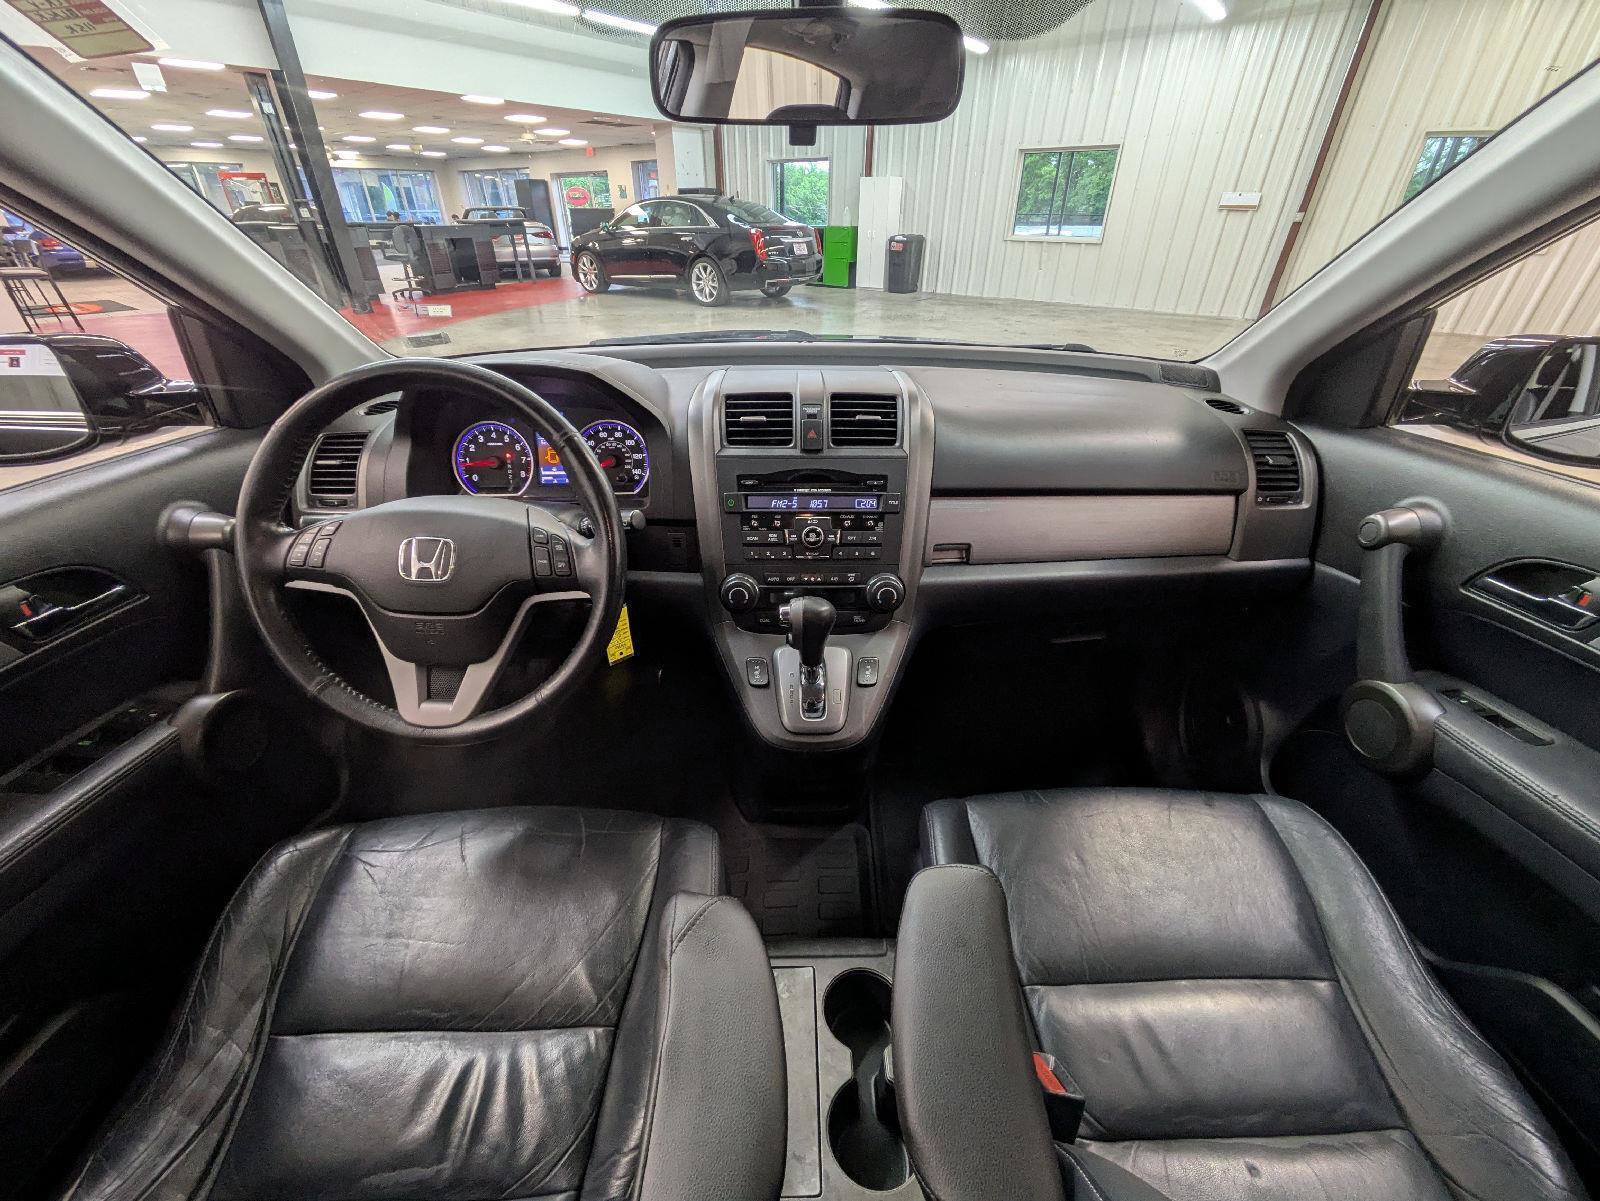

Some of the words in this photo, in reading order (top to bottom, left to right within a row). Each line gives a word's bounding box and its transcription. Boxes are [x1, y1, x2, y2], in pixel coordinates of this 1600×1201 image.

[477, 435, 484, 443] 3
[469, 444, 476, 452] 2
[520, 456, 527, 464] 7
[472, 474, 479, 482] 0
